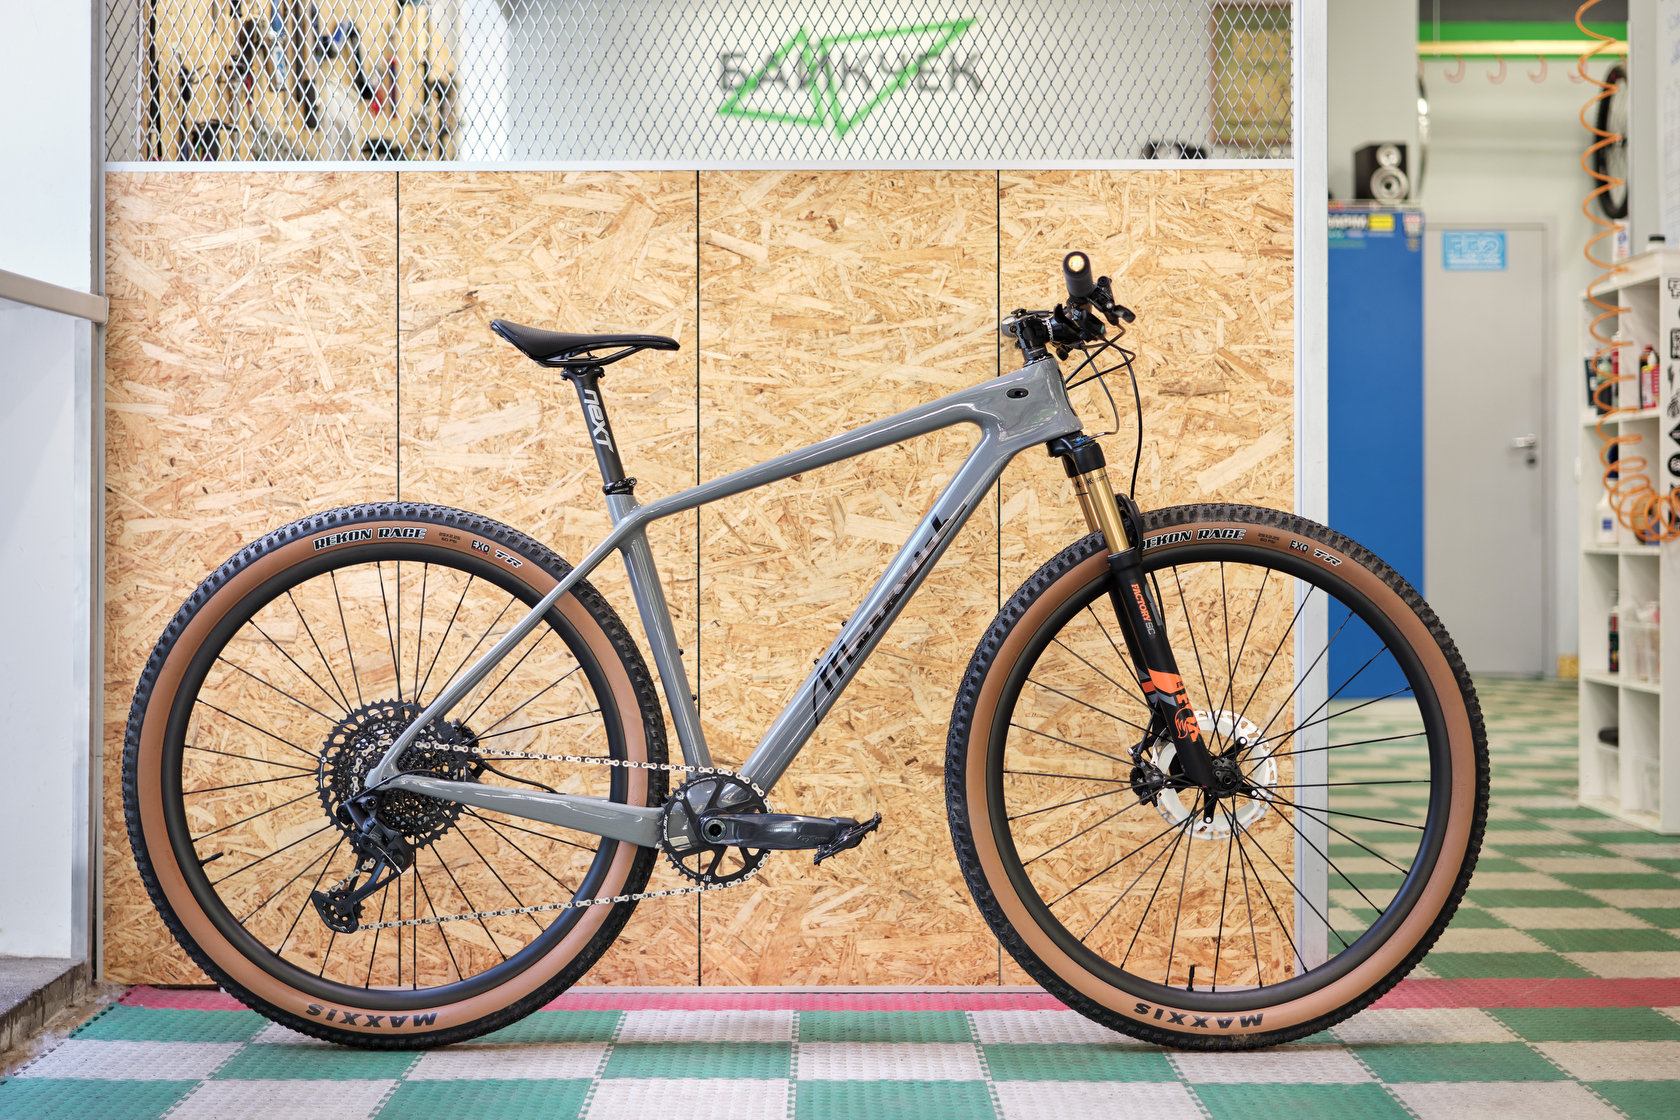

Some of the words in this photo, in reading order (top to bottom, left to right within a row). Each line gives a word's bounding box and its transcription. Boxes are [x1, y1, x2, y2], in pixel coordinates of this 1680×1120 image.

[720, 43, 983, 93] БАЙКЧЕК
[312, 528, 373, 551] REKON
[377, 527, 428, 539] RACE
[1197, 528, 1247, 540] RACE
[471, 539, 491, 554] EXO
[495, 549, 523, 568] TR
[1289, 539, 1309, 554] EXO
[1313, 548, 1342, 567] TR
[1130, 583, 1152, 622] FACTORY
[306, 1003, 438, 1028] MAXXIS
[1133, 1002, 1264, 1029] MAXXIS
